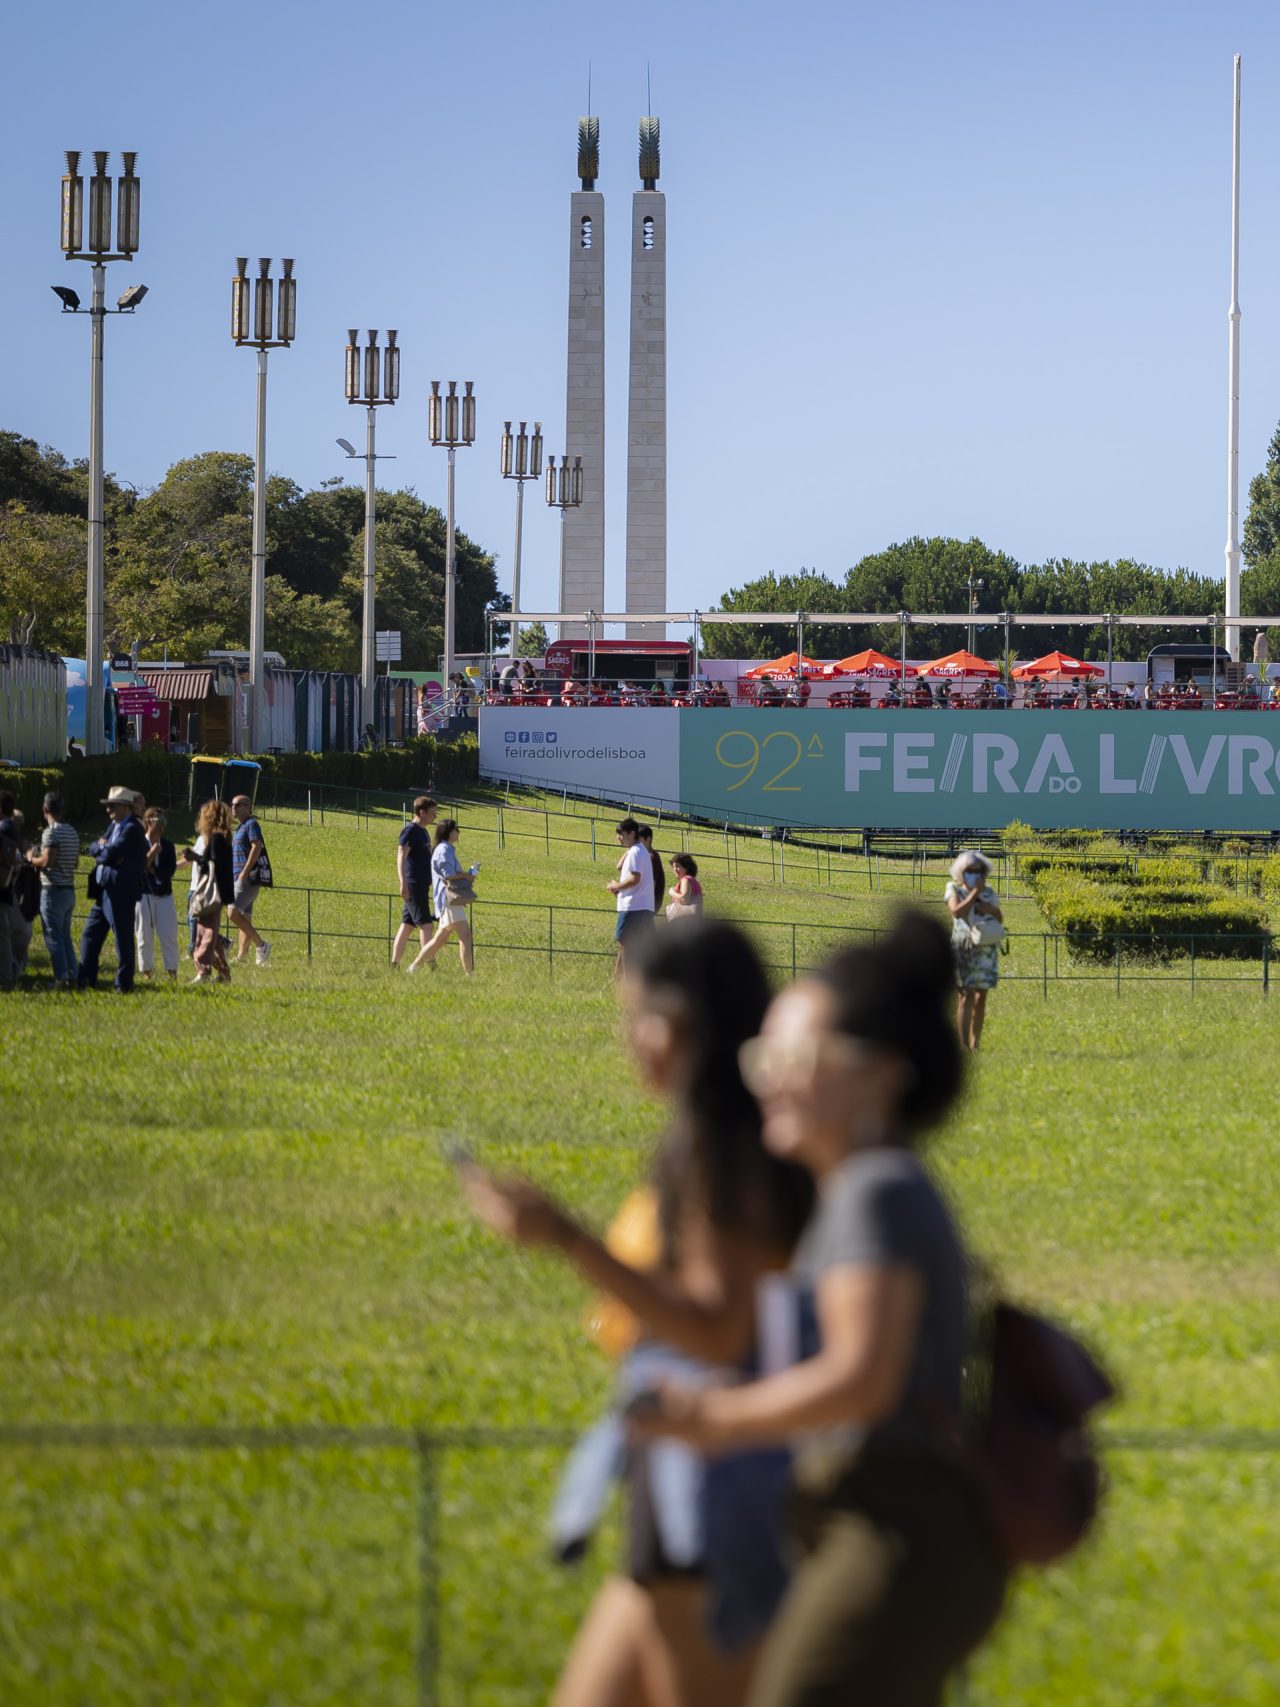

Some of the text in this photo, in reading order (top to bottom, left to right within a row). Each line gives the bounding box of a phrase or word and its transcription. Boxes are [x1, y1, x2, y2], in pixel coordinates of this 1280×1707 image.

[548, 656, 570, 664] SAGRES
[867, 667, 896, 678] SAGRES
[933, 667, 964, 676] SAGRES
[505, 746, 646, 759] feiradolivrodelisboa
[845, 732, 1075, 794] FEIRA
[1049, 777, 1082, 794] DO
